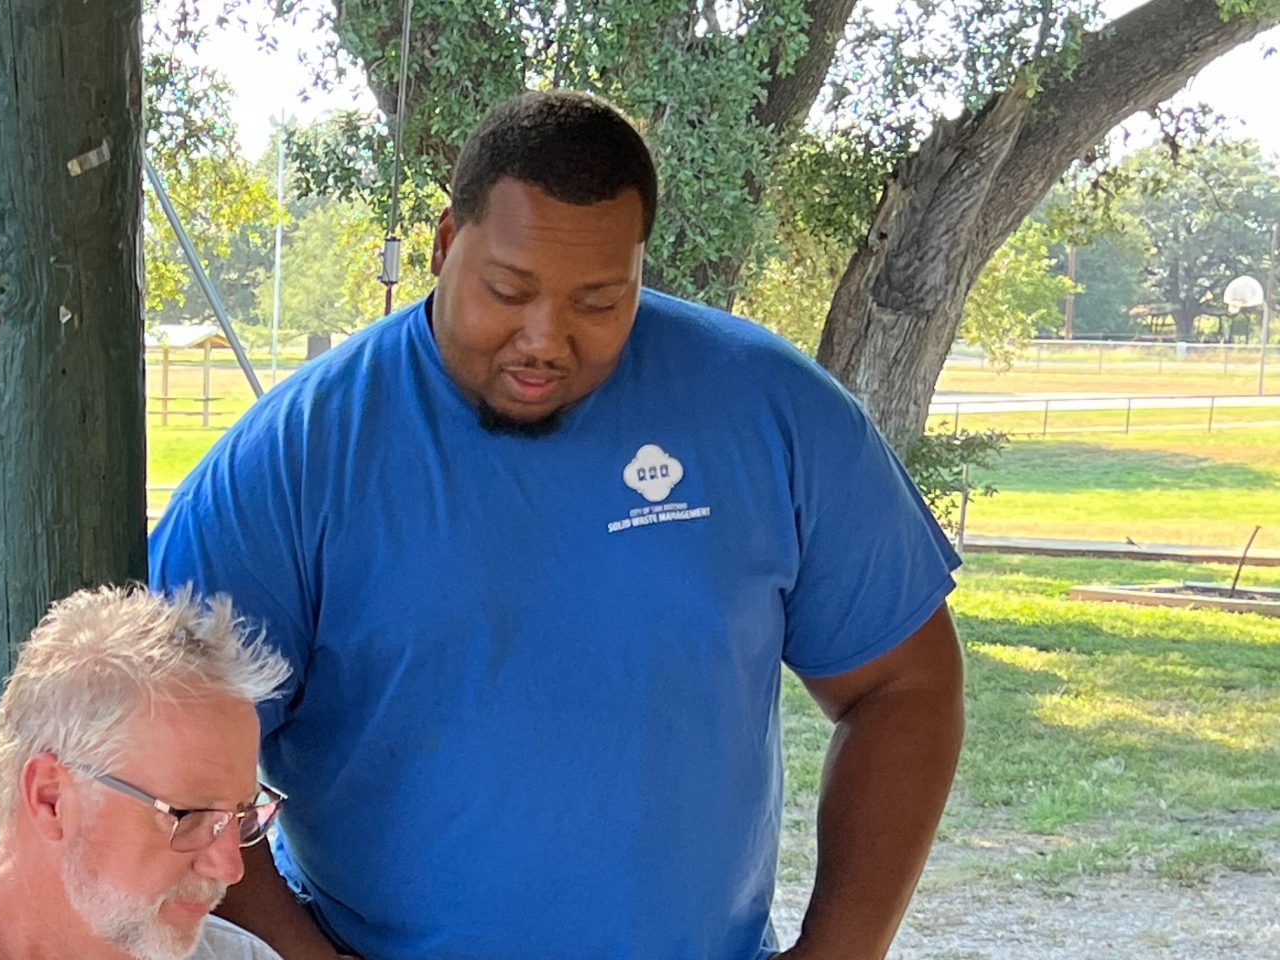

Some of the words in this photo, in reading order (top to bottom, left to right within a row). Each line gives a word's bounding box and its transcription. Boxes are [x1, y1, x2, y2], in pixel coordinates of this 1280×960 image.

[608, 519, 631, 533] SOLID
[631, 514, 658, 527] WASTE
[658, 507, 710, 521] MANAGEMENT
